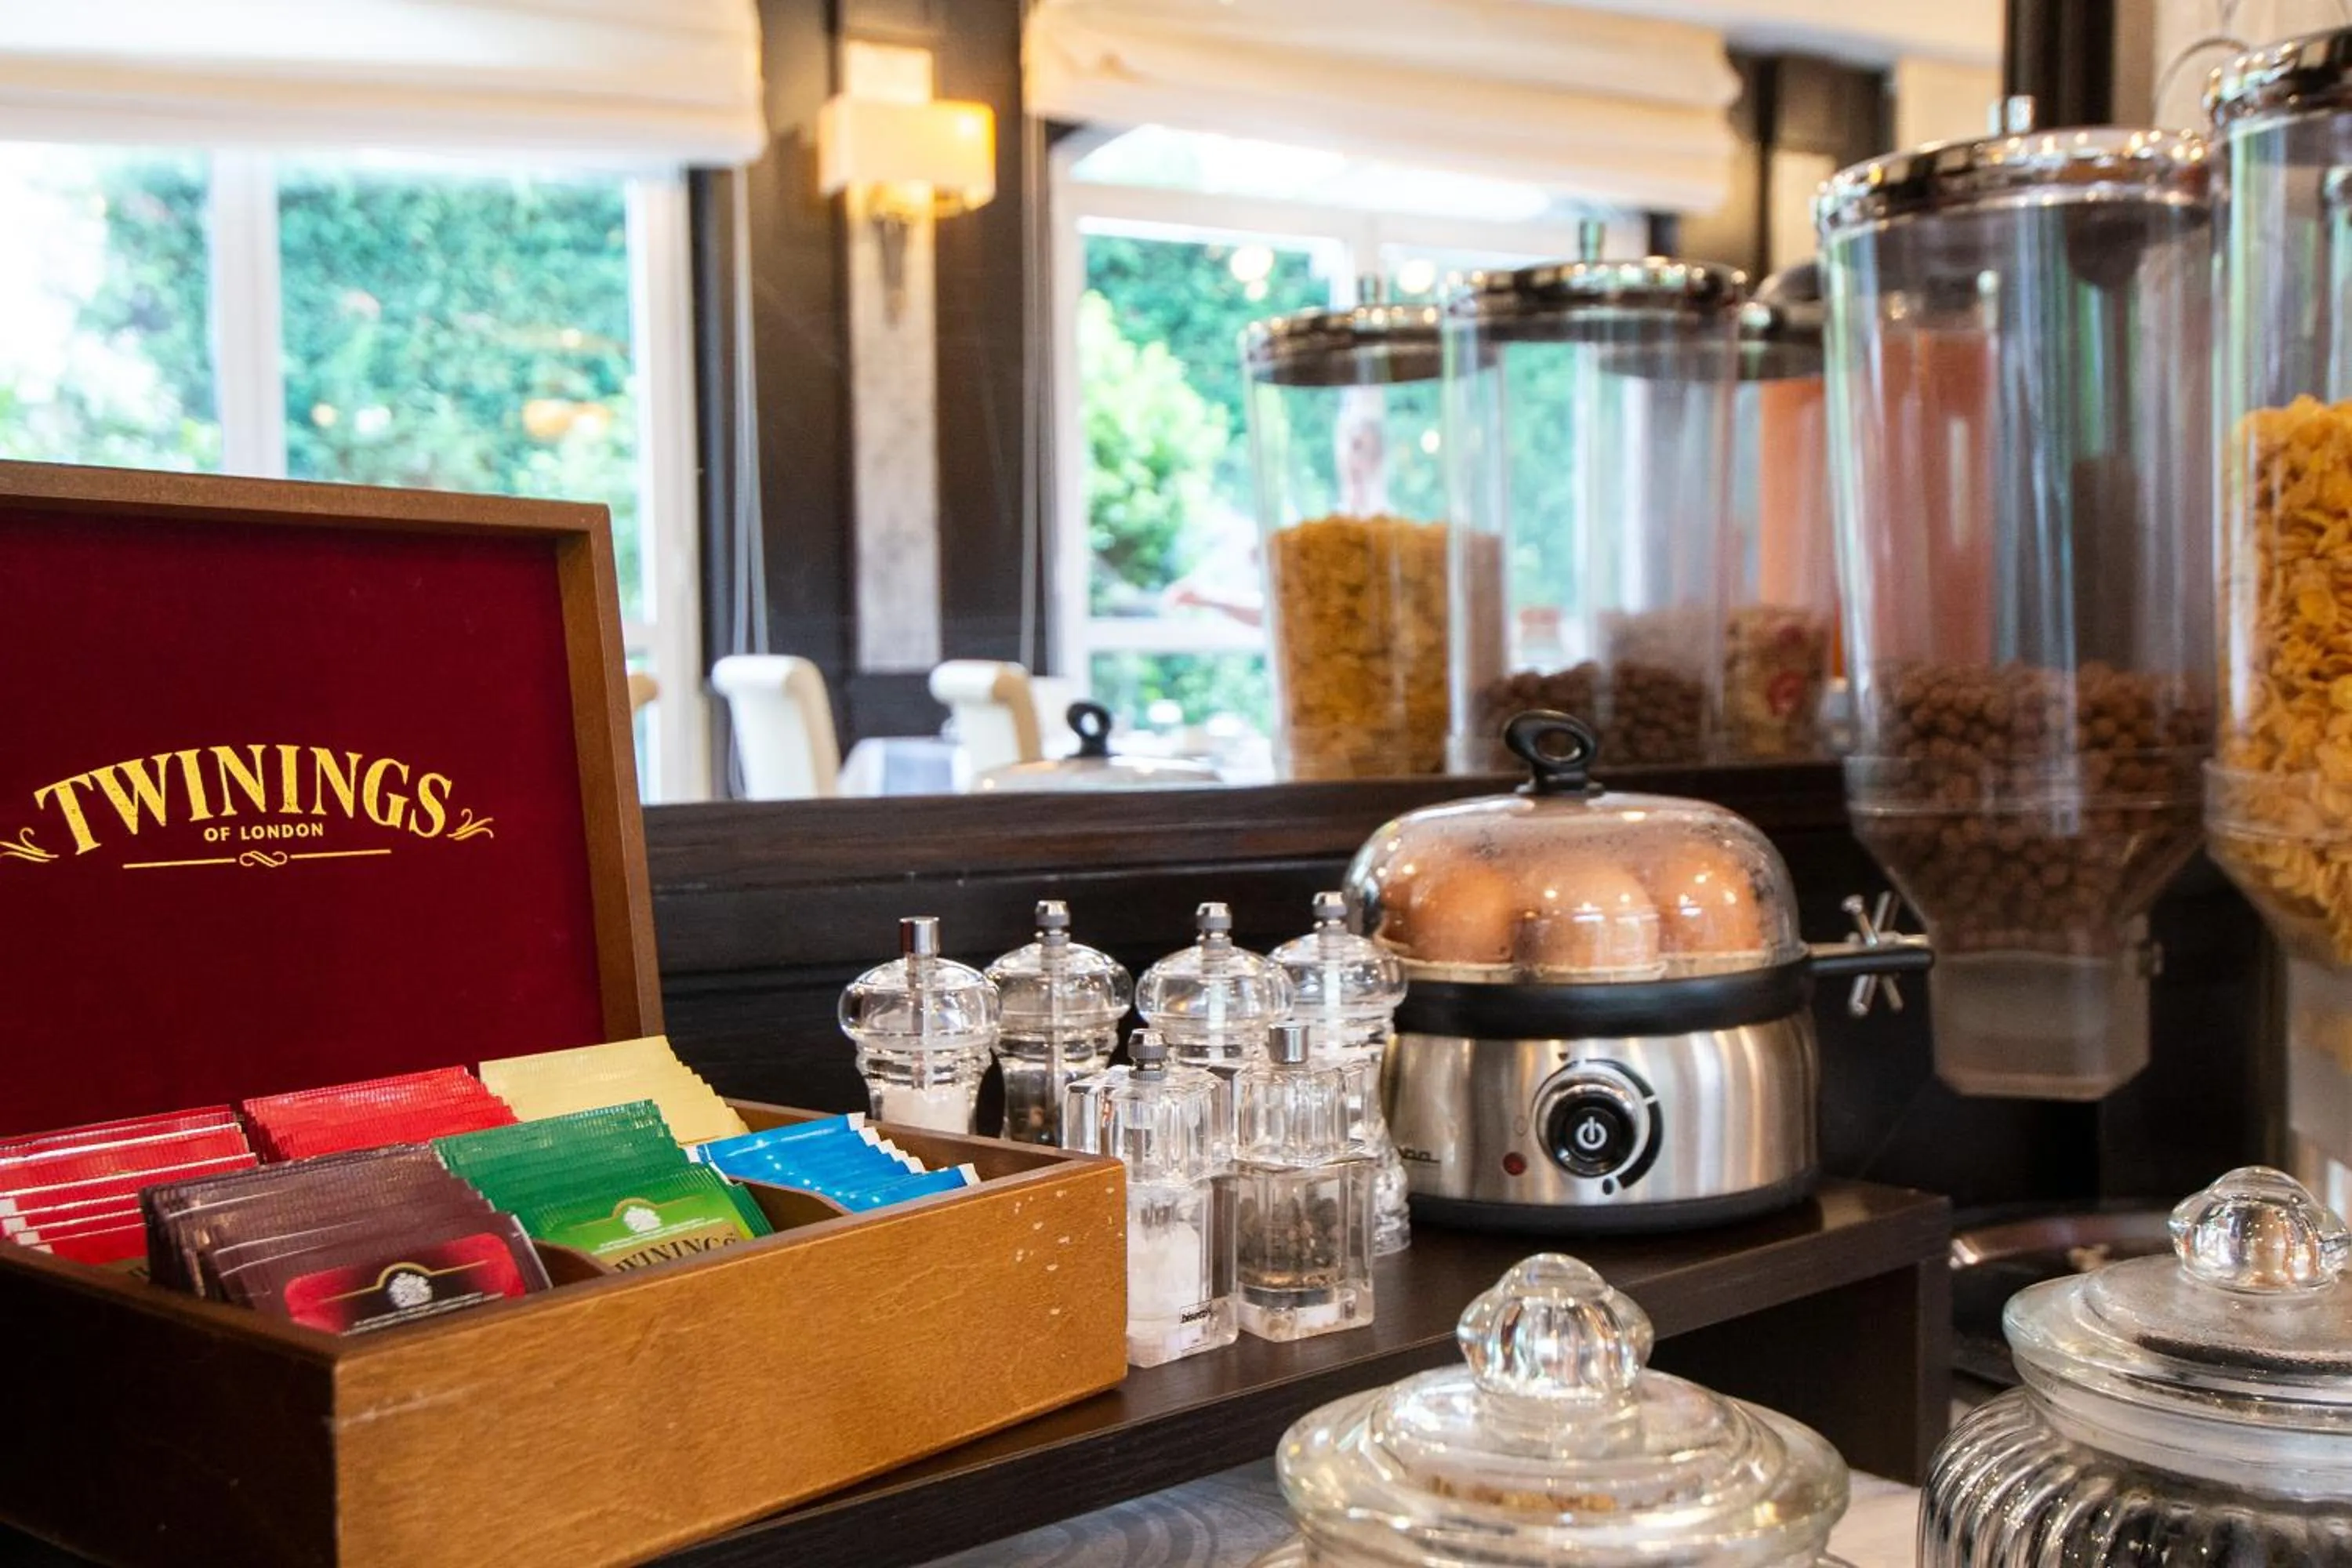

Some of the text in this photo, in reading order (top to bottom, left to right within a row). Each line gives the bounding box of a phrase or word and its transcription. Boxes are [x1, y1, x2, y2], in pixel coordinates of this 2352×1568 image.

[34, 744, 452, 855] TWININGS
[204, 822, 324, 841] OF LONDON
